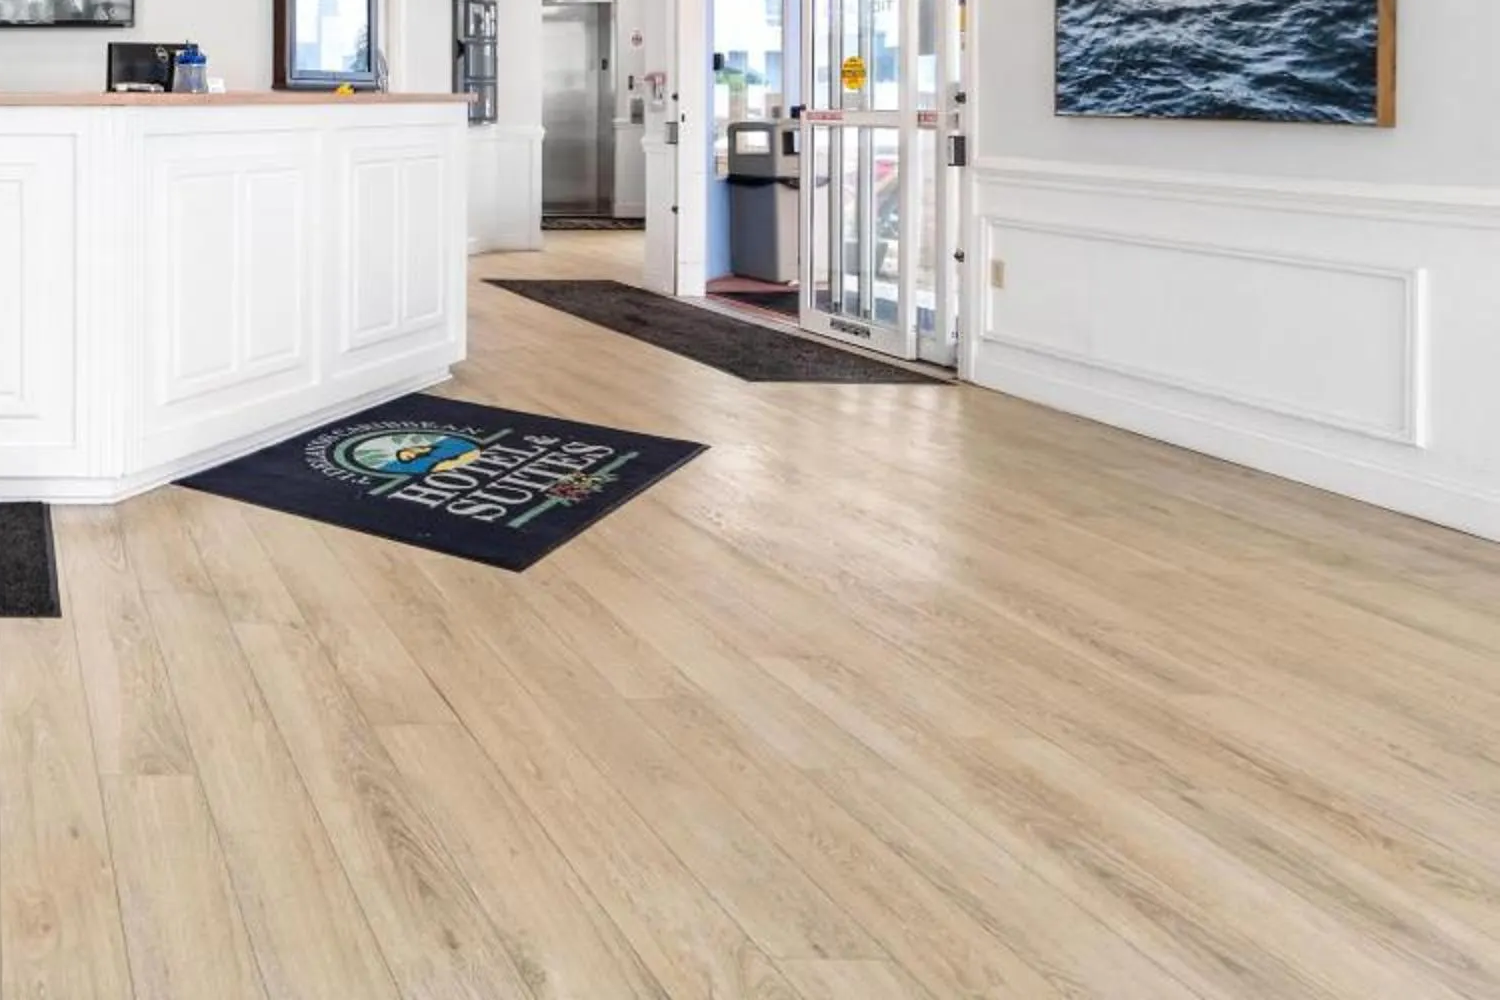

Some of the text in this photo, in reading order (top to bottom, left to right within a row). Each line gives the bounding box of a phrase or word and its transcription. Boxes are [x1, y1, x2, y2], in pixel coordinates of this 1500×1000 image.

[386, 435, 561, 508] HOTEL &
[446, 441, 615, 523] SUITES
